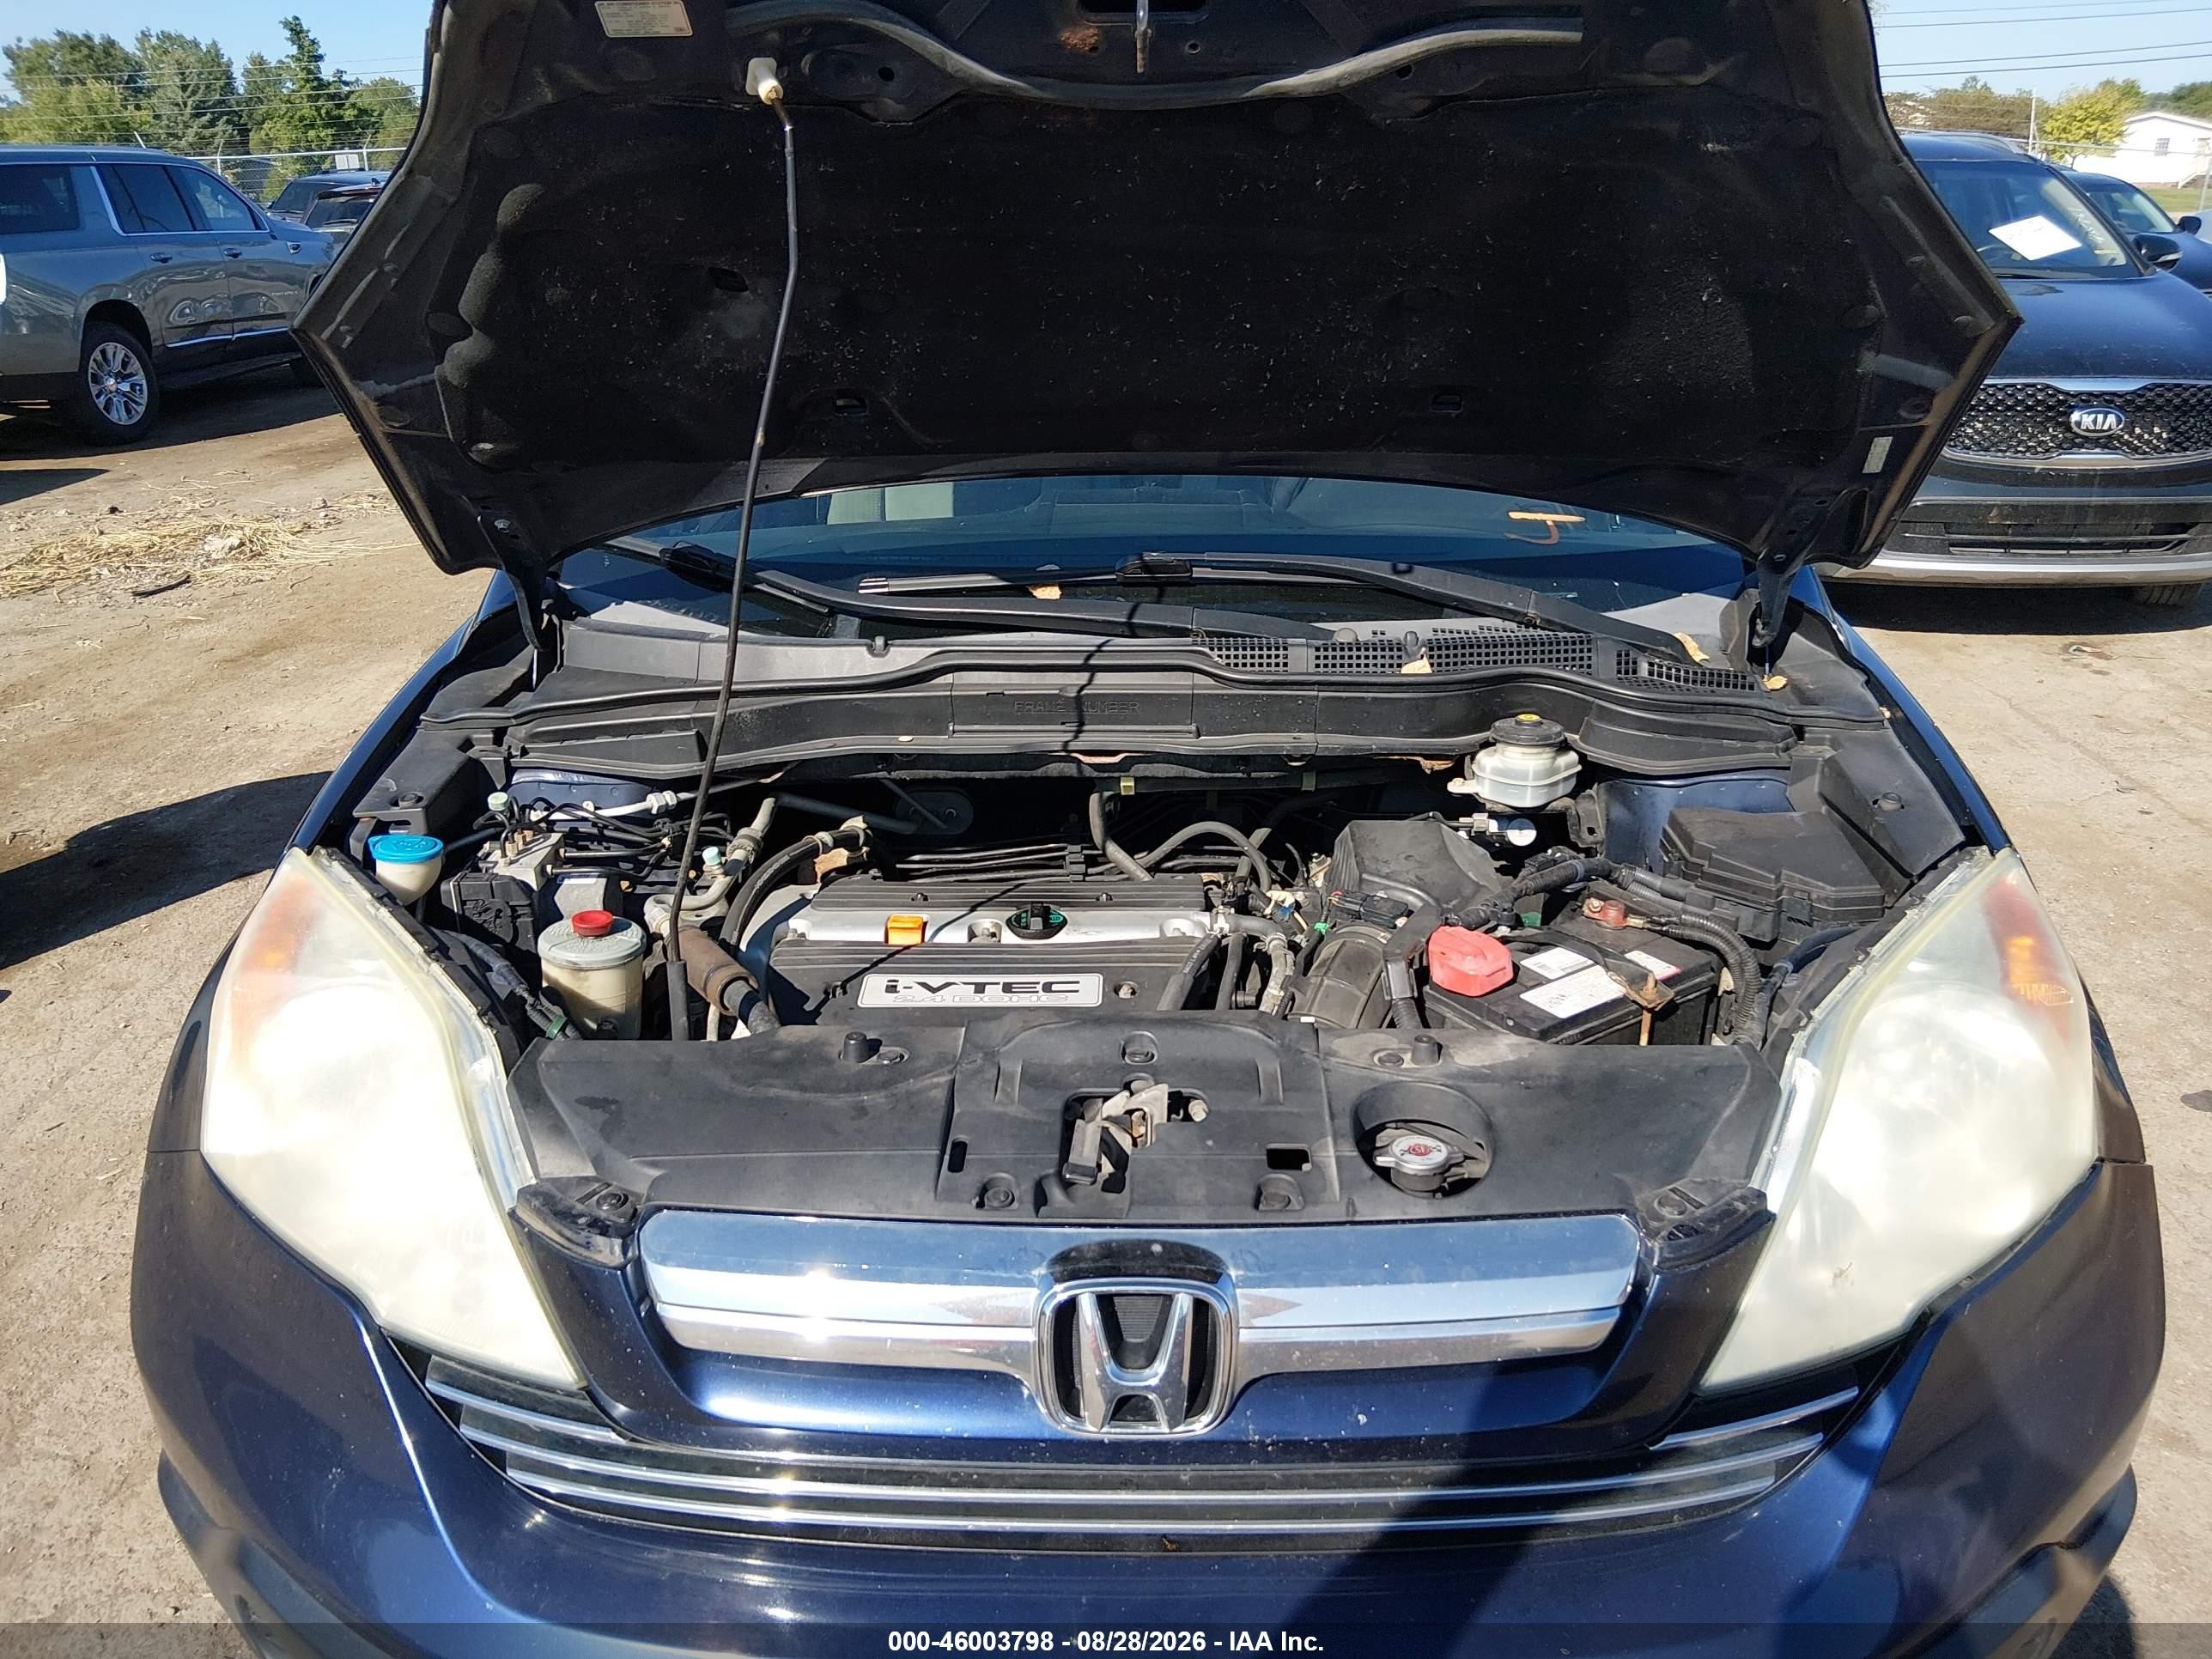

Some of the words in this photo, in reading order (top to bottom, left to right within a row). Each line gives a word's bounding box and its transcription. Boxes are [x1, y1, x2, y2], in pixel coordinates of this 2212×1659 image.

[2081, 414, 2117, 430] KIA
[1014, 700, 1066, 713] FRAME
[884, 979, 1080, 994] i-VTEC
[893, 994, 945, 1004] 2.4
[952, 994, 1068, 1004] DOHC
